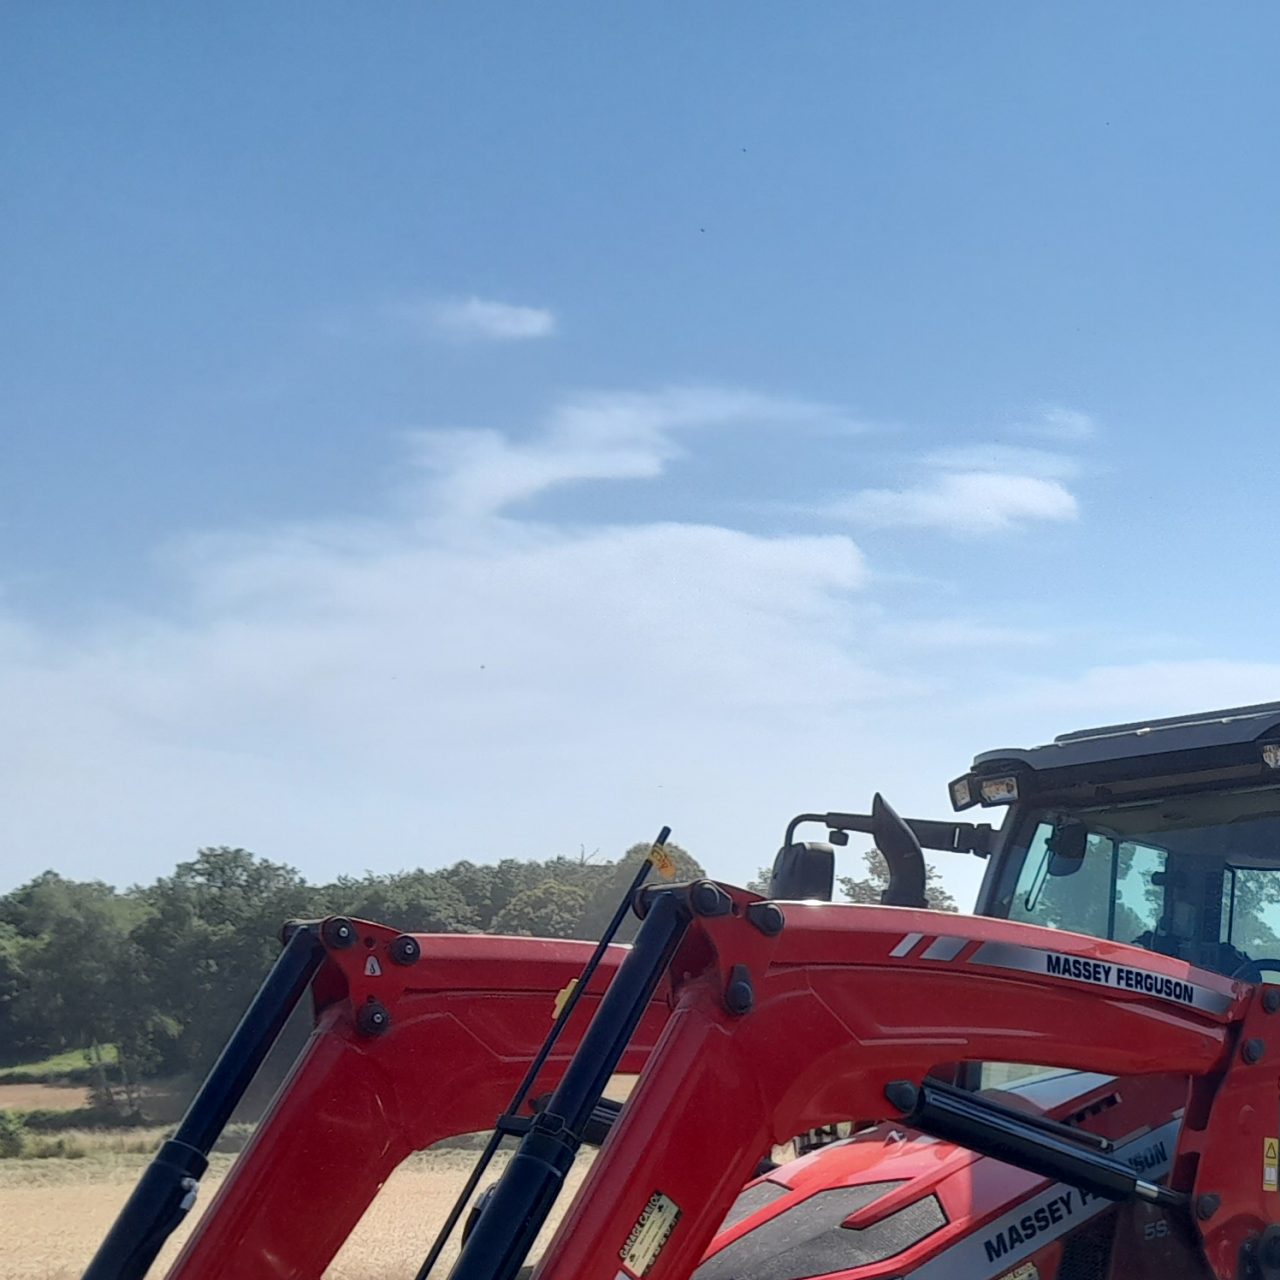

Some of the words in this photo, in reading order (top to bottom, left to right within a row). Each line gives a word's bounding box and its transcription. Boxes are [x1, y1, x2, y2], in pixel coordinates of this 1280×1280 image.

[1046, 954, 1112, 984] MASSEY
[1116, 967, 1194, 1003] FERGUSON
[619, 1222, 642, 1259] GARAGE
[983, 1191, 1074, 1263] MASSEY
